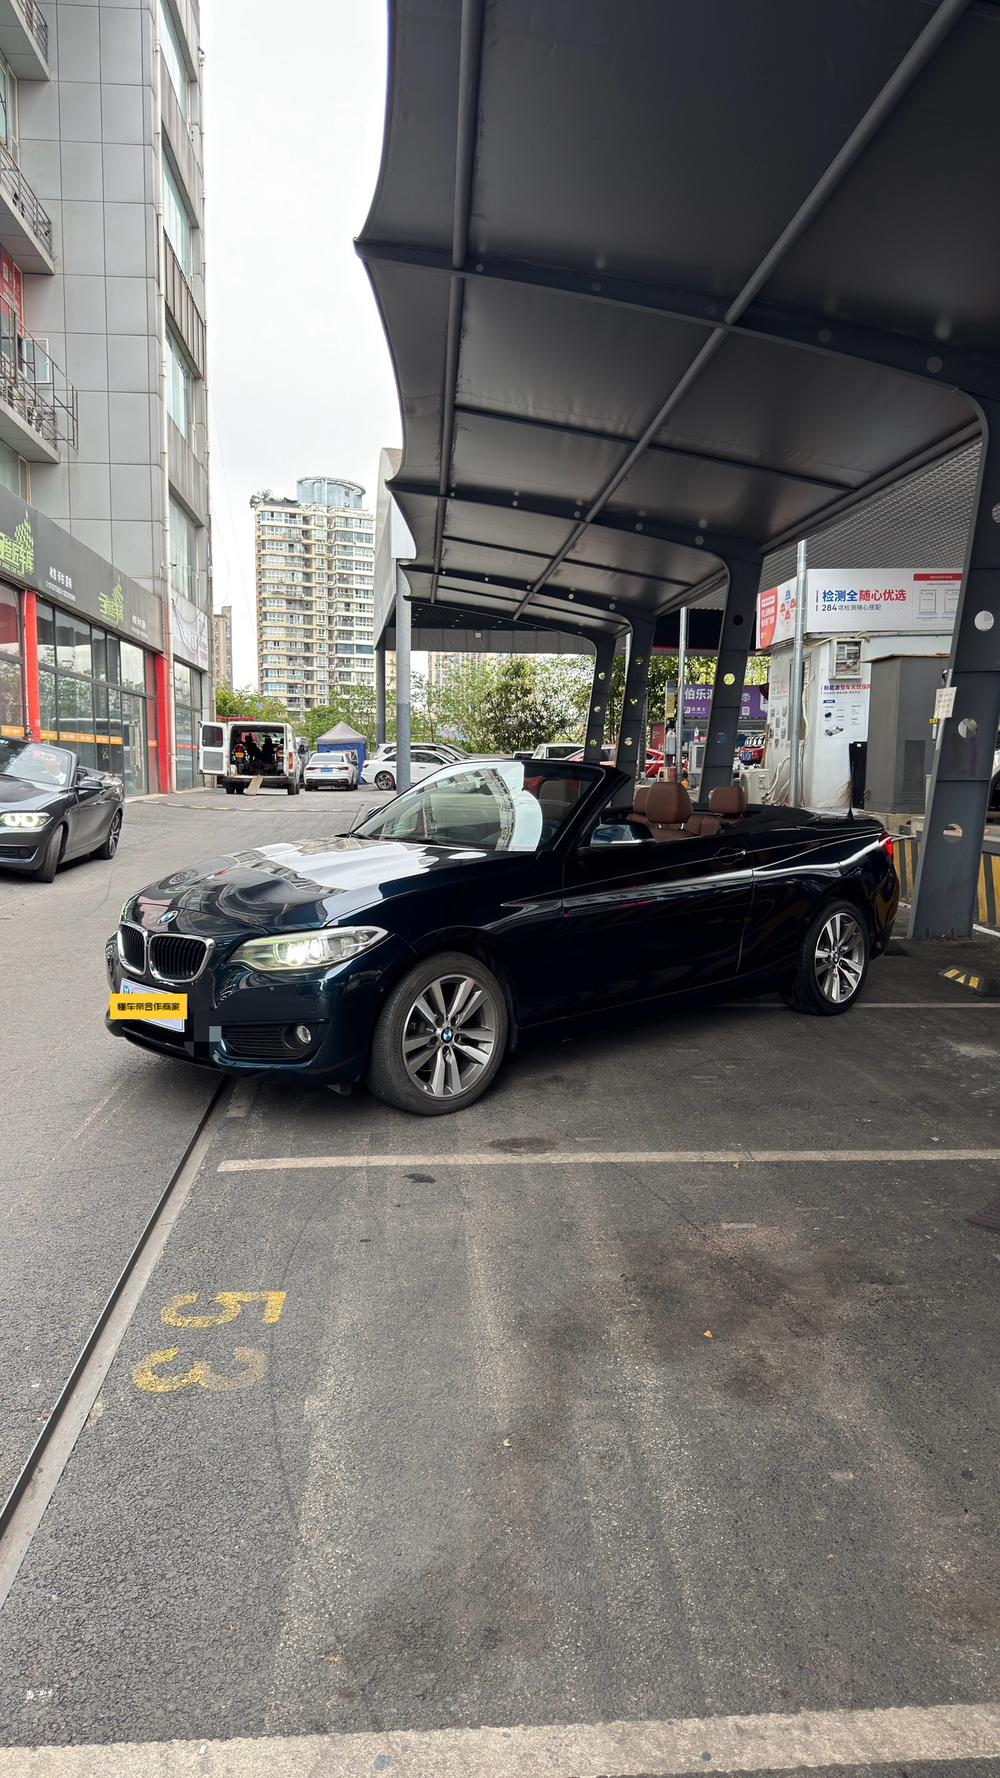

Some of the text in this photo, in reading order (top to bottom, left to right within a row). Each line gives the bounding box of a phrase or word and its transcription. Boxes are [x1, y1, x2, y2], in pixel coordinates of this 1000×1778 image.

[822, 589, 907, 602] 检测全随心优选
[132, 1290, 288, 1394] 53
